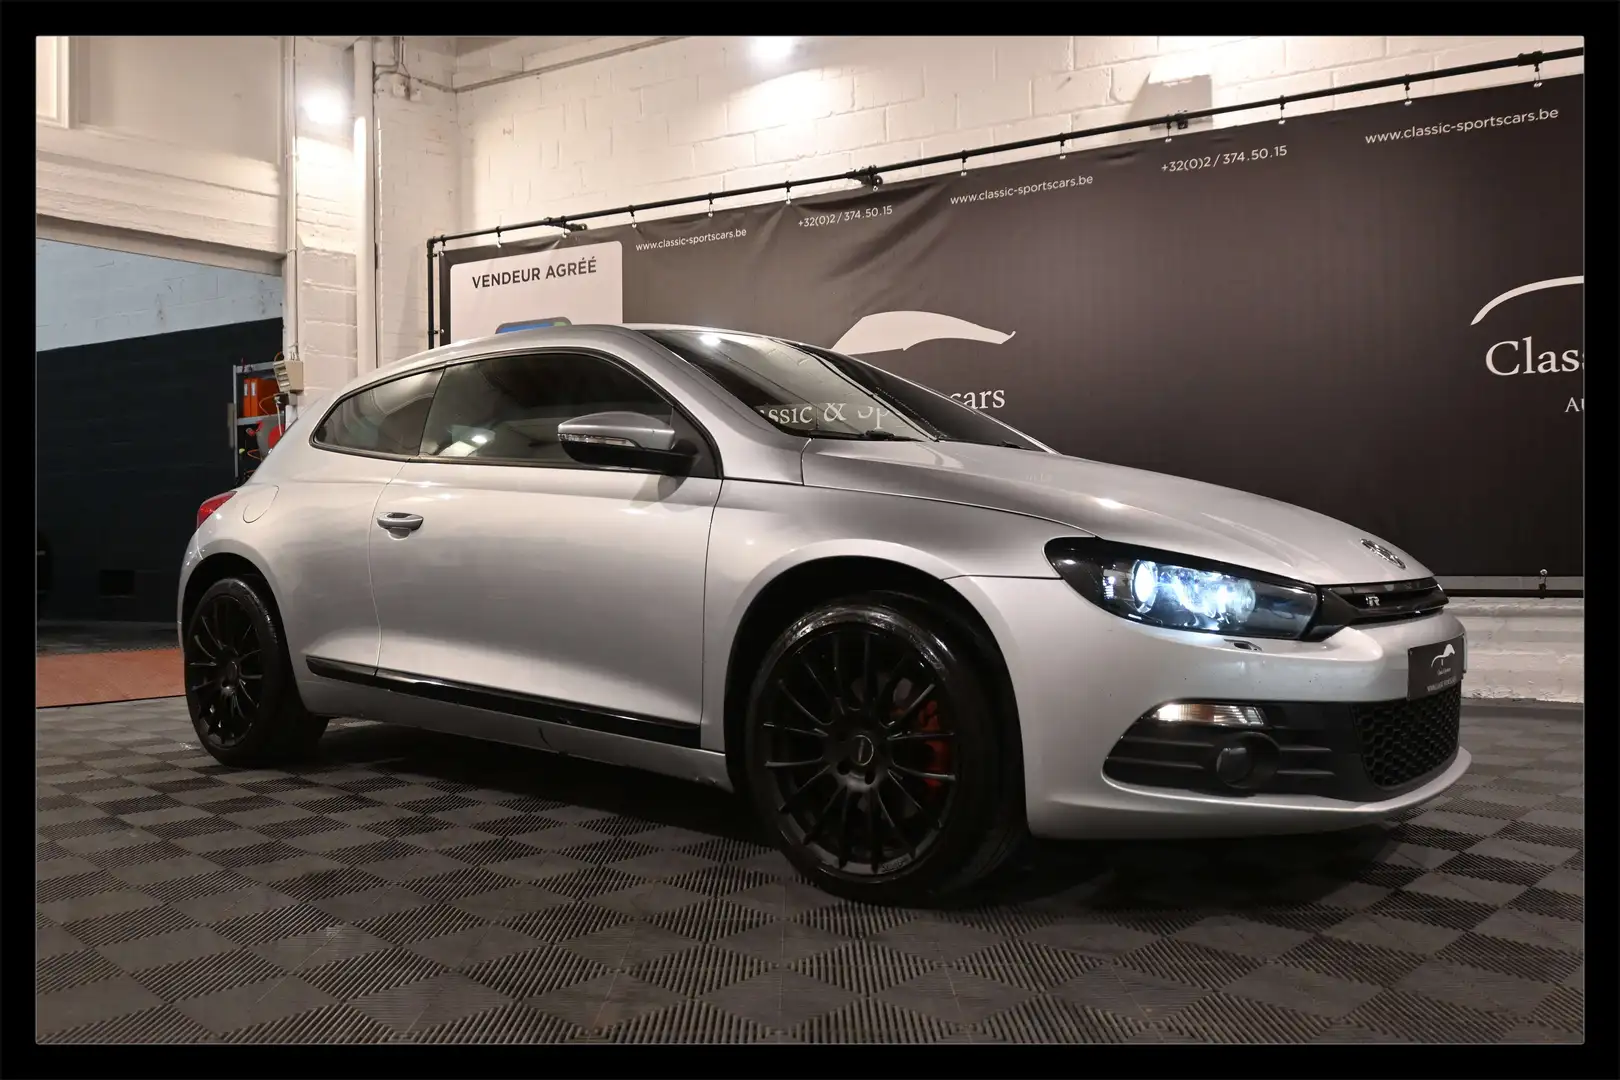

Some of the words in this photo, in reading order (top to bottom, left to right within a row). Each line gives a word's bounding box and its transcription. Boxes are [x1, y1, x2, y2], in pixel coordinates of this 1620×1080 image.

[1365, 108, 1559, 144] www.classic-sportscars.be
[950, 174, 1094, 205] www.classic-sportscars.be
[635, 228, 747, 251] www.classic-sportscars.be
[472, 267, 541, 289] VENDEUR
[545, 256, 597, 280] AGRÉÉ
[1485, 335, 1584, 376] Clas
[759, 404, 813, 424] ssic
